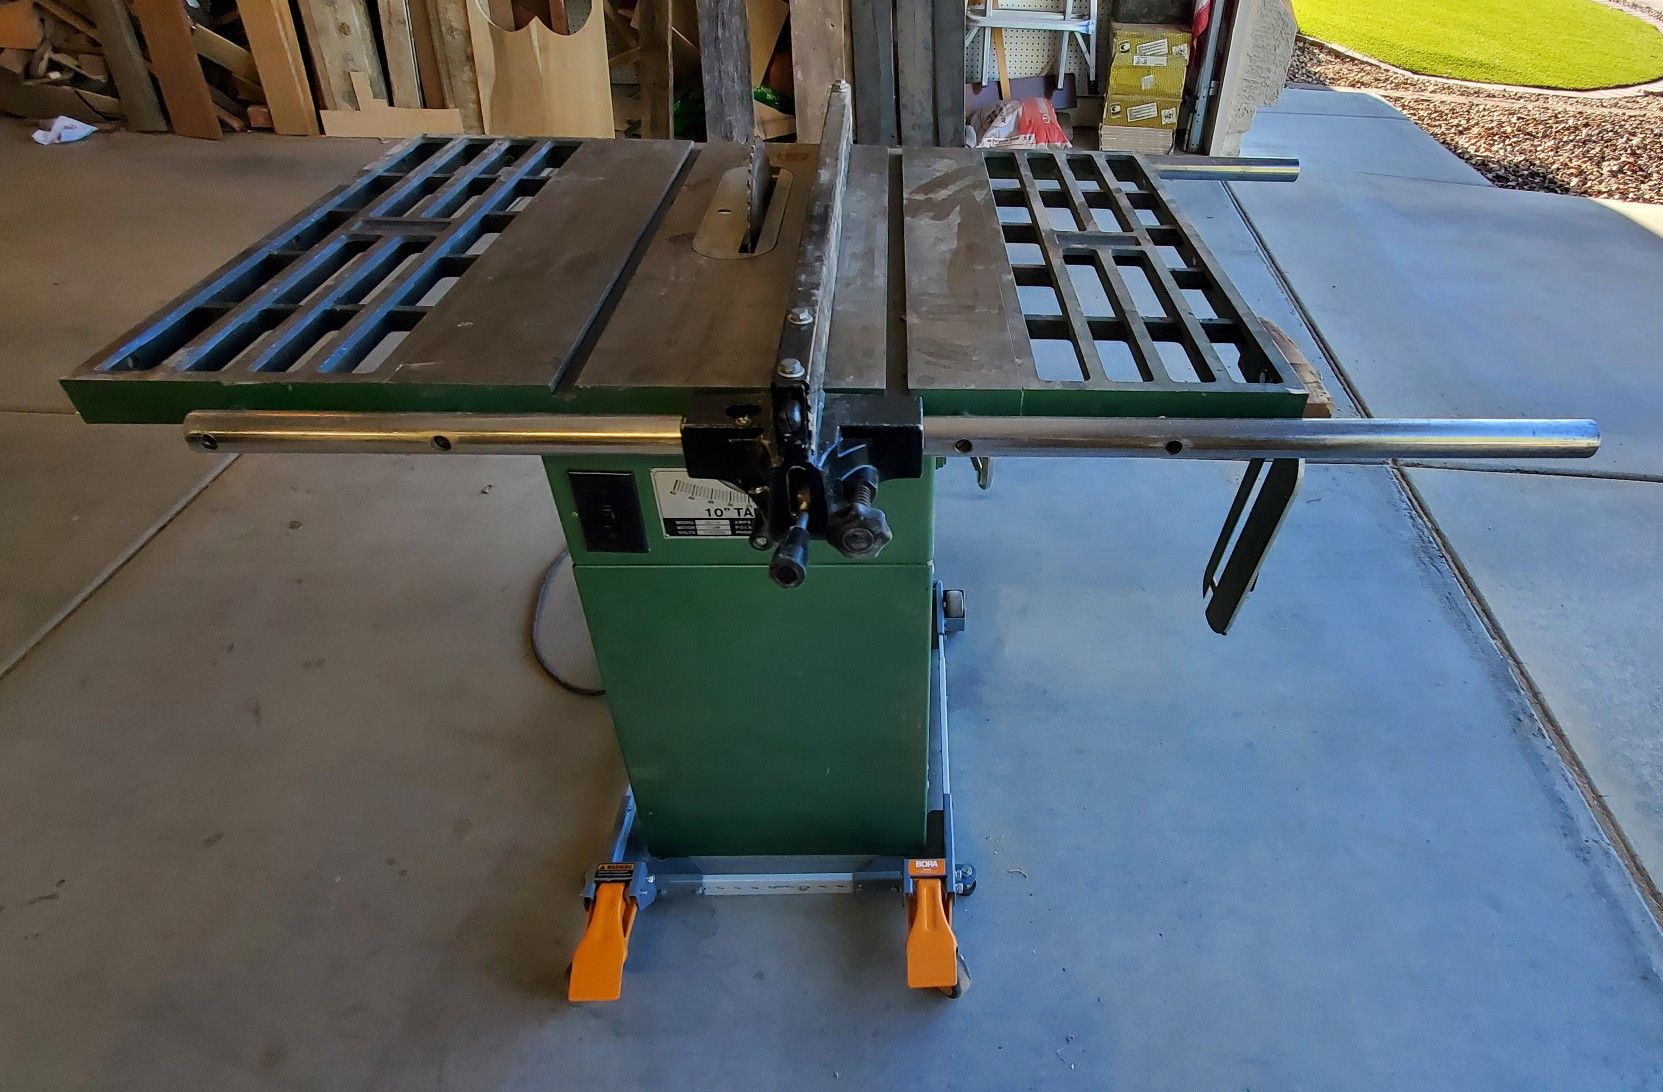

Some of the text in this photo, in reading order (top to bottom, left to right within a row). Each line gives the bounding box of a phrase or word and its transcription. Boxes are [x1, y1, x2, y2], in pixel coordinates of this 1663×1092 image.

[704, 508, 756, 518] 10" TA
[915, 860, 938, 868] BORA
